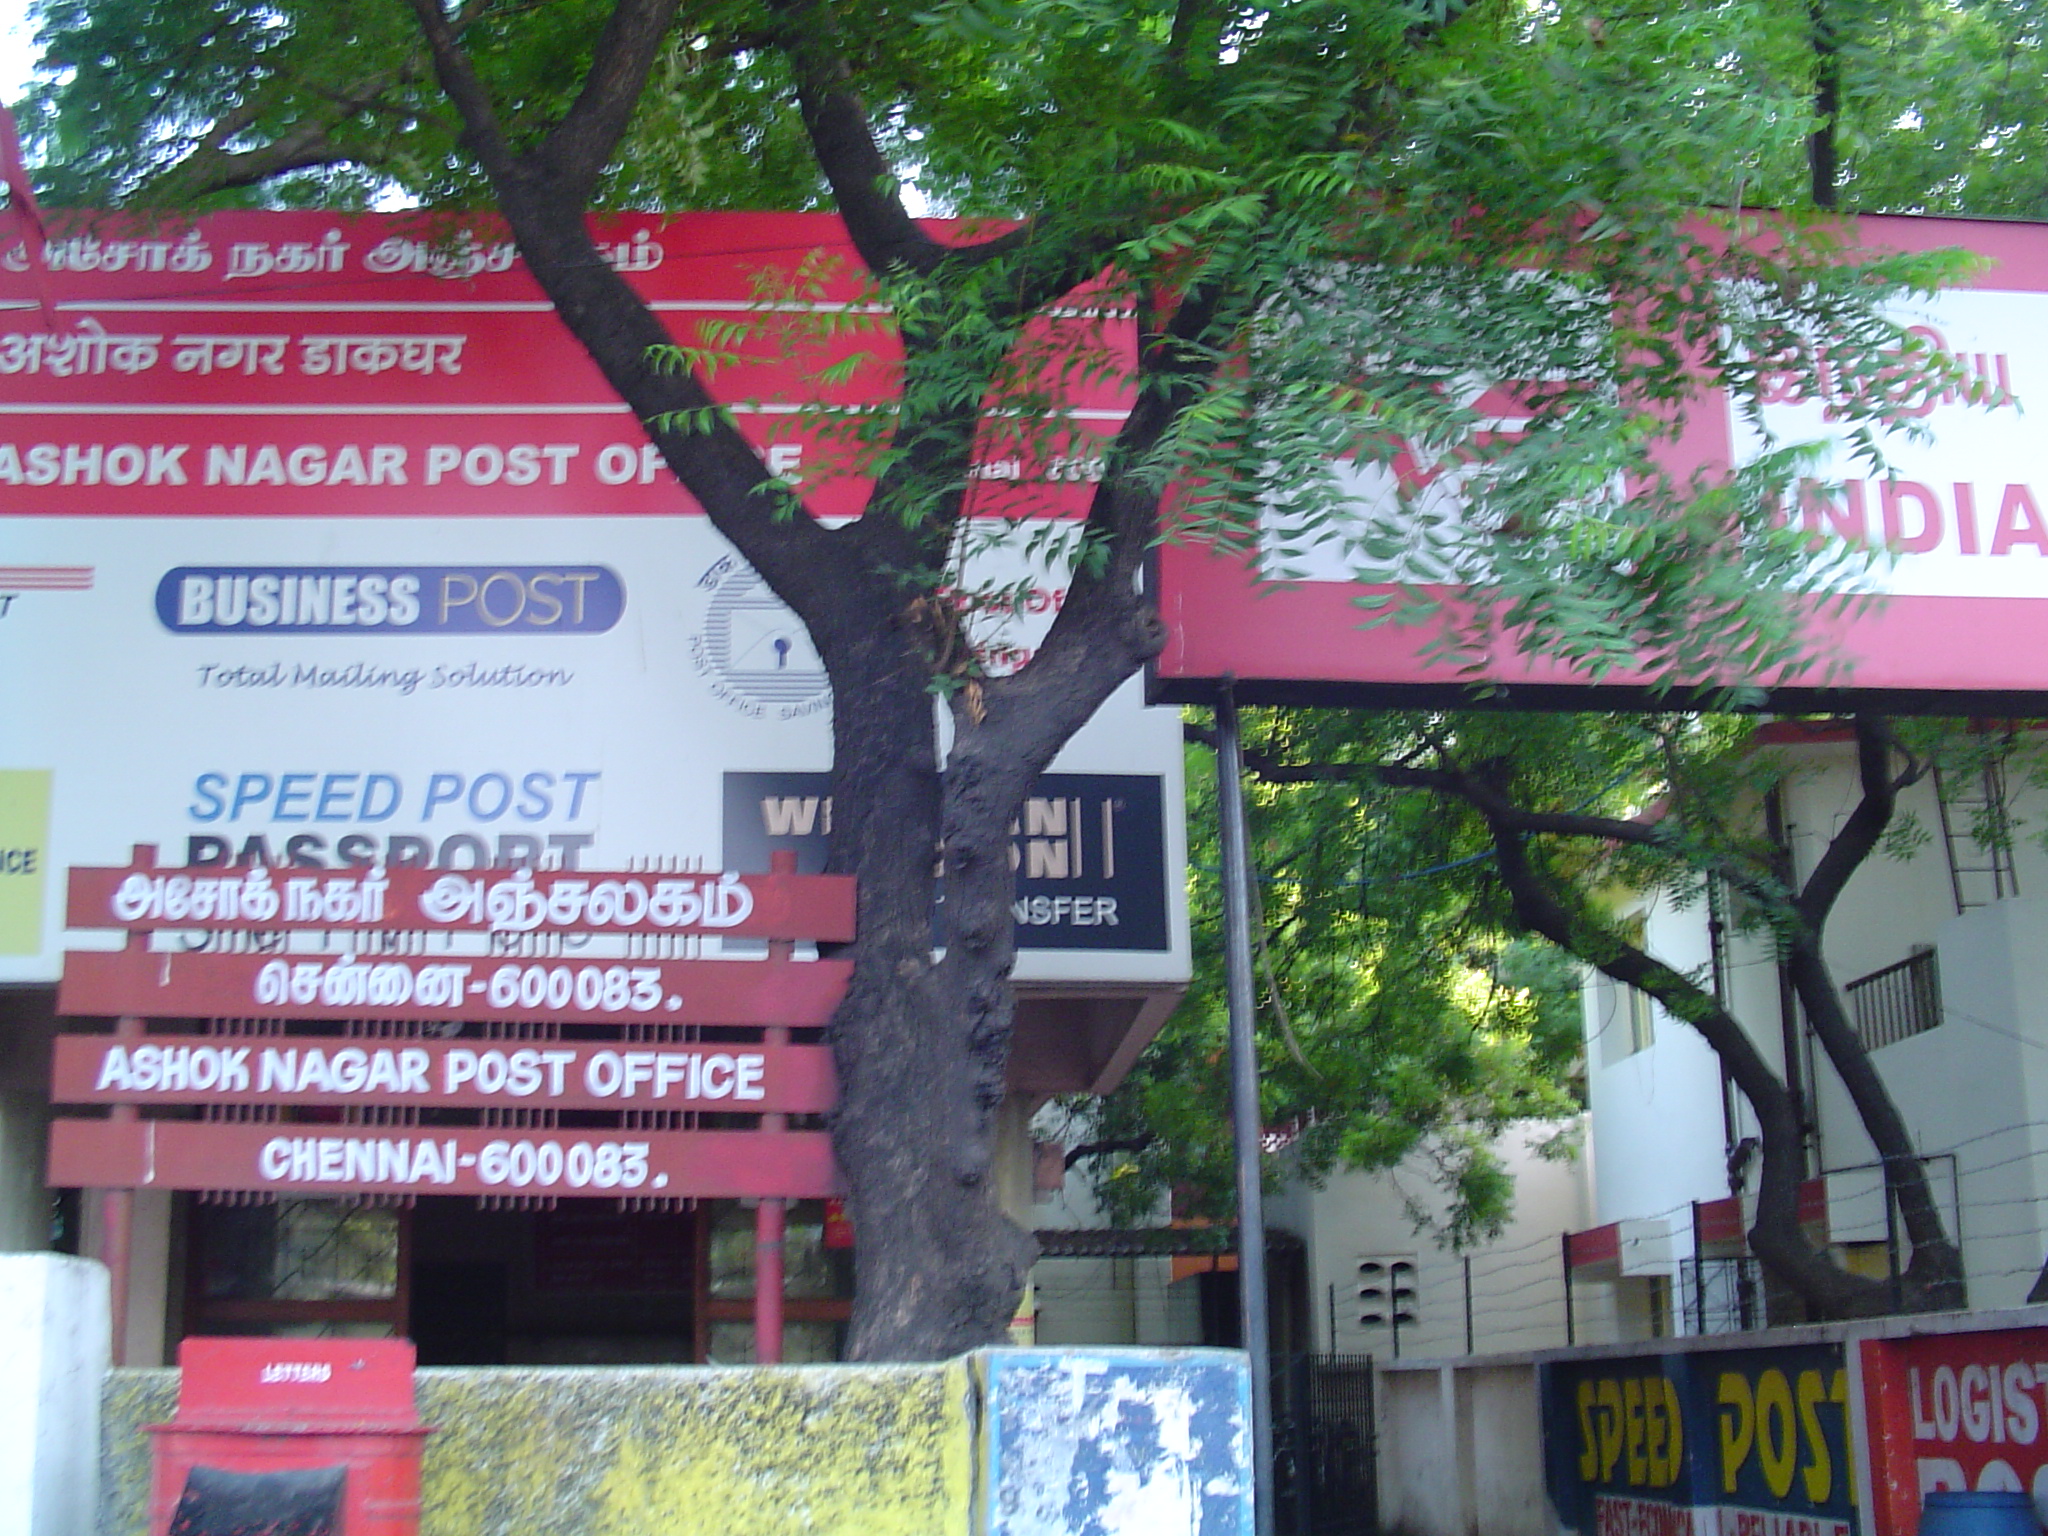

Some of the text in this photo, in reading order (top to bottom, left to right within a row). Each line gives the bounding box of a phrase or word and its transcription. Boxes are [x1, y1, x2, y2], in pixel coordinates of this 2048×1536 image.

[222, 227, 351, 281] நகர்
[0, 317, 467, 377] अशोक नगर डाकघर
[0, 442, 803, 488] ASHOK NAGAR POST OFE
[176, 572, 599, 628] BUSINESS POST
[196, 662, 574, 696] Total Mailing Solution
[189, 771, 601, 823] SPEED POST
[186, 832, 596, 871] PASSPORT
[418, 867, 754, 931] அஞ்சலகம்
[1009, 894, 1120, 926] NSFER
[95, 1046, 766, 1101] ASHOK NAGAR POST OFFICE
[1578, 1377, 1684, 1488] SPEED
